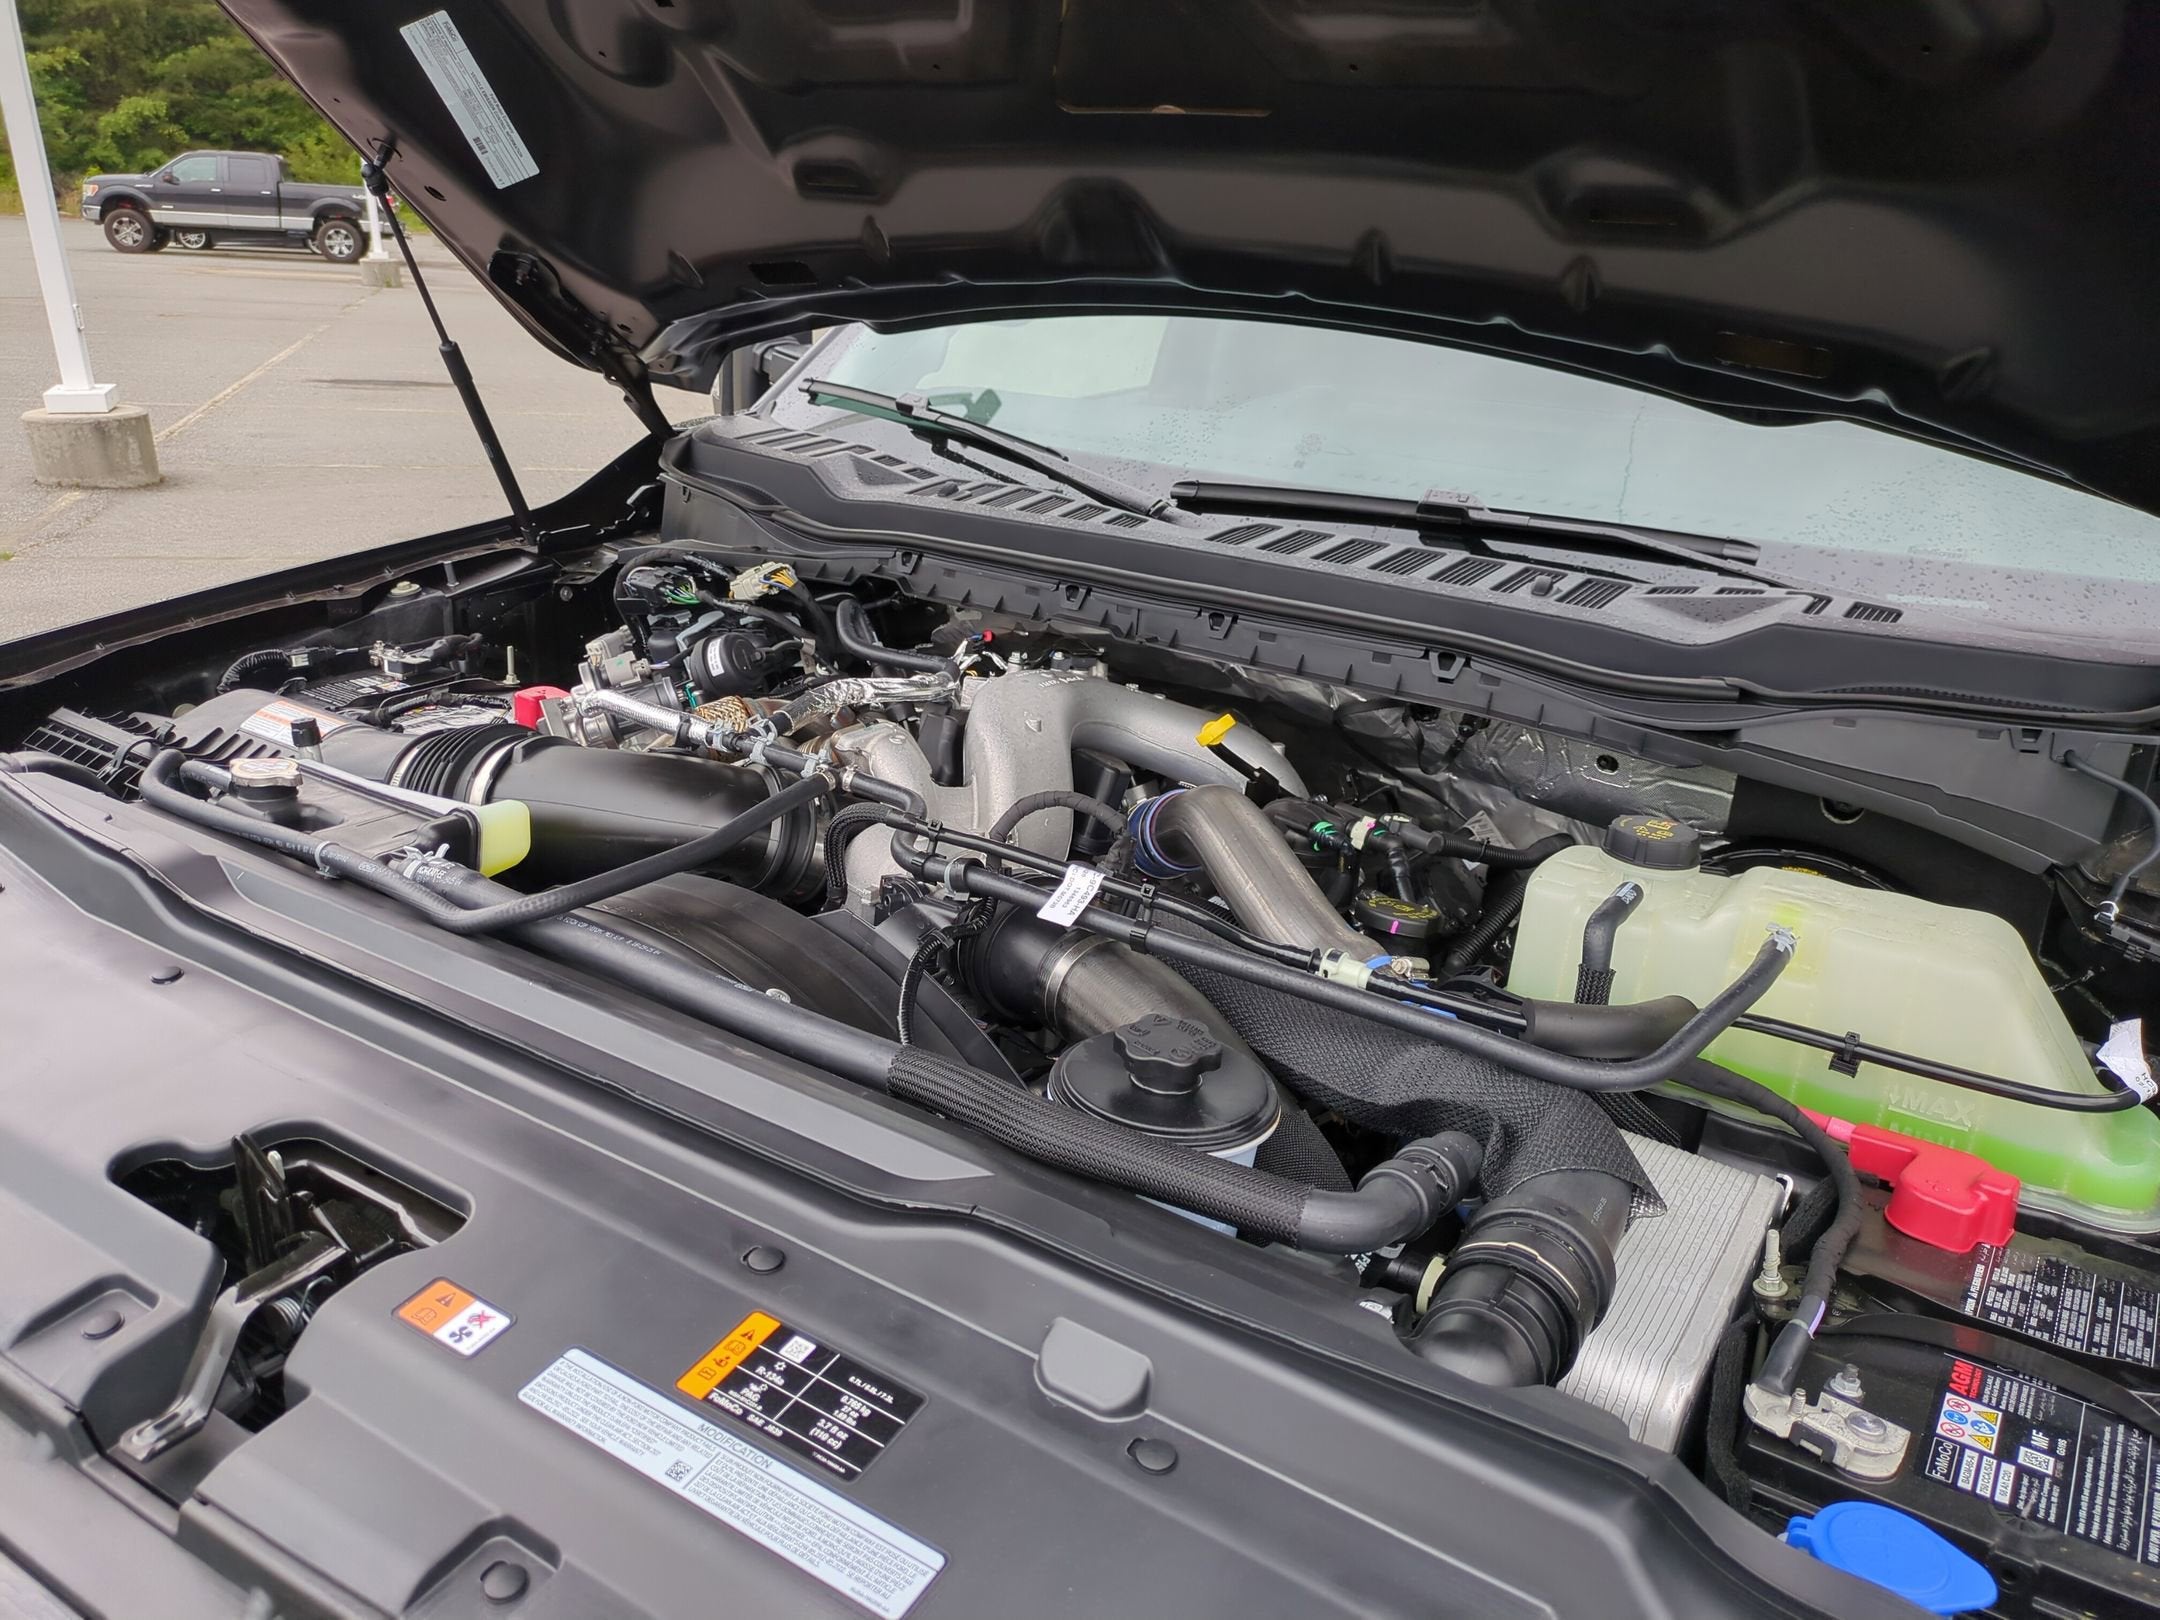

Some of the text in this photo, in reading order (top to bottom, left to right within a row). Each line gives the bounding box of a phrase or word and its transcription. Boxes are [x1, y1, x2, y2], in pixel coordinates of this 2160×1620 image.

[1902, 1087, 1975, 1128] MAX
[755, 1366, 784, 1385] R-134a
[1950, 1361, 1972, 1394] AGM
[1969, 1368, 1981, 1397] TECHNOLOGY
[740, 1387, 760, 1401] PAG
[840, 1395, 871, 1416] 0.765 kg
[708, 1392, 742, 1414] FoMoCo
[746, 1413, 764, 1426] SAE
[816, 1418, 832, 1429] 3.7
[698, 1423, 772, 1468] MODIFICATION
[809, 1427, 842, 1449] (110 cc)
[2030, 1429, 2048, 1448] MF
[1932, 1442, 1952, 1479] FoMoCo
[1981, 1458, 1993, 1483] CCA/SAE
[2001, 1469, 2011, 1481] C20
